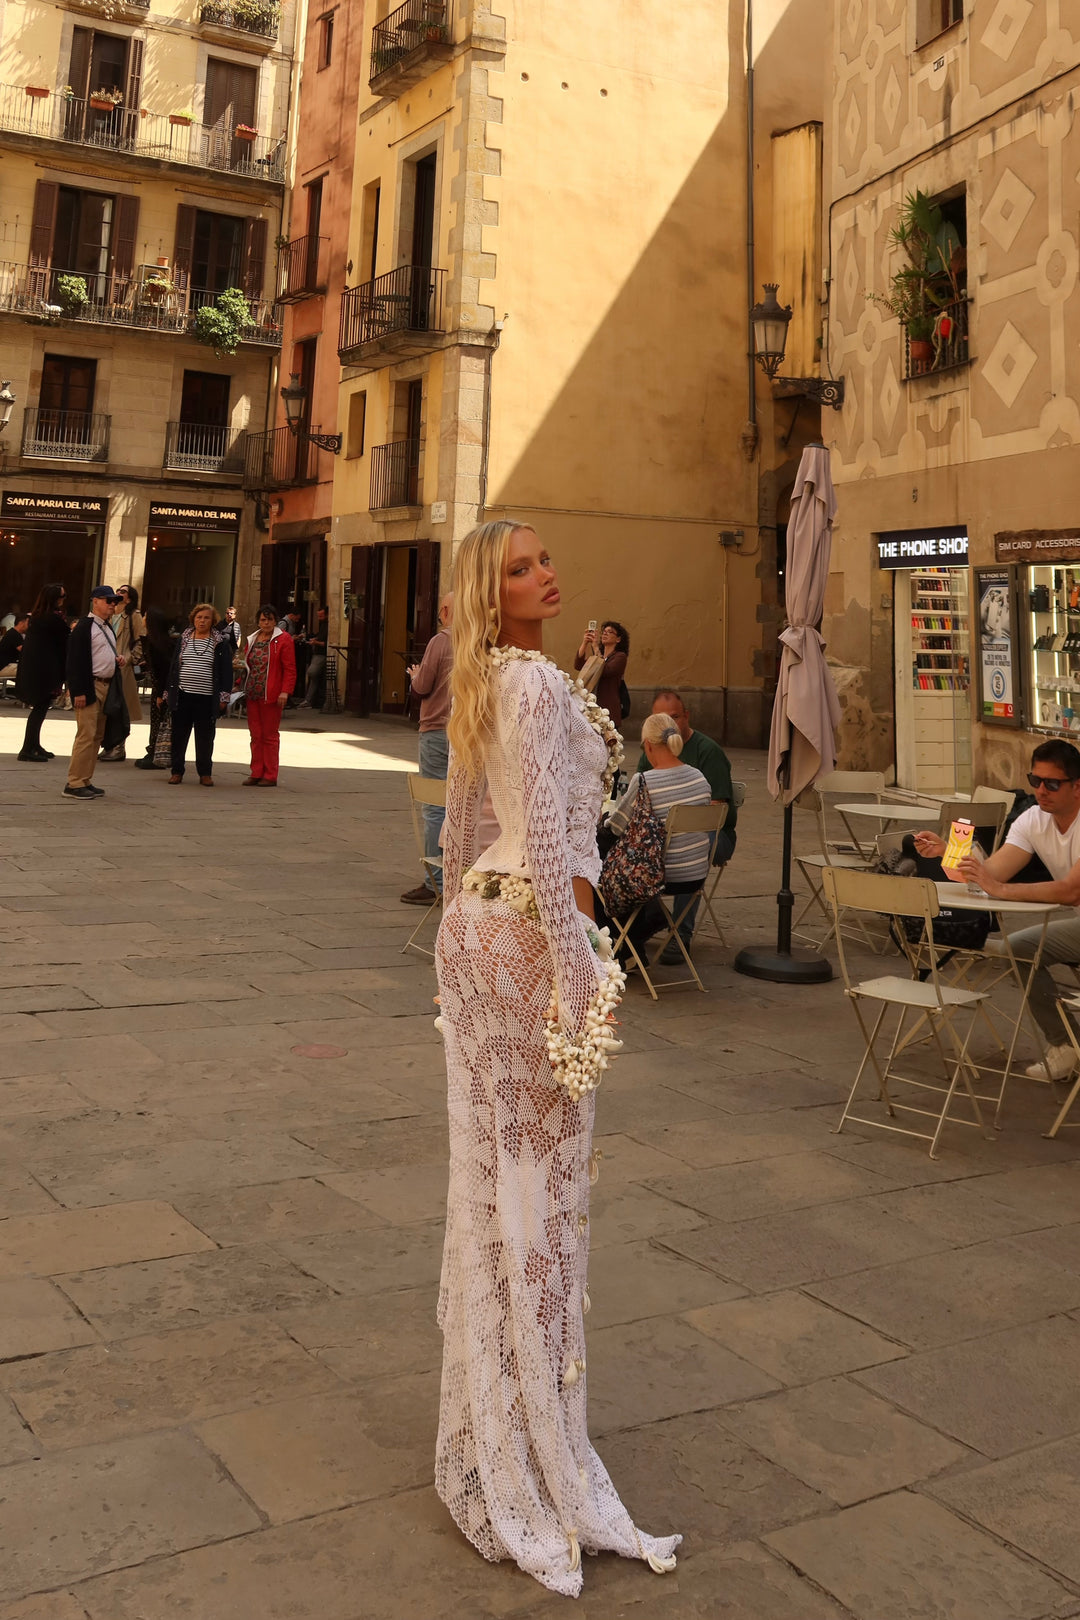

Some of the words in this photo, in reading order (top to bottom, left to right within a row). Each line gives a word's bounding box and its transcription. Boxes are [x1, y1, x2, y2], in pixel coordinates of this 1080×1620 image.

[6, 497, 35, 506] SANTA
[37, 499, 63, 508] MARIA
[65, 501, 81, 509] DEL
[83, 502, 101, 510] MAR
[151, 507, 177, 516] SANTA
[178, 509, 203, 517] MARIA
[204, 510, 219, 519] DEL
[220, 512, 237, 520] MAR
[878, 542, 898, 558] THE
[900, 539, 936, 556] PHONE
[999, 542, 1012, 551] SIM
[1012, 541, 1032, 550] CARD
